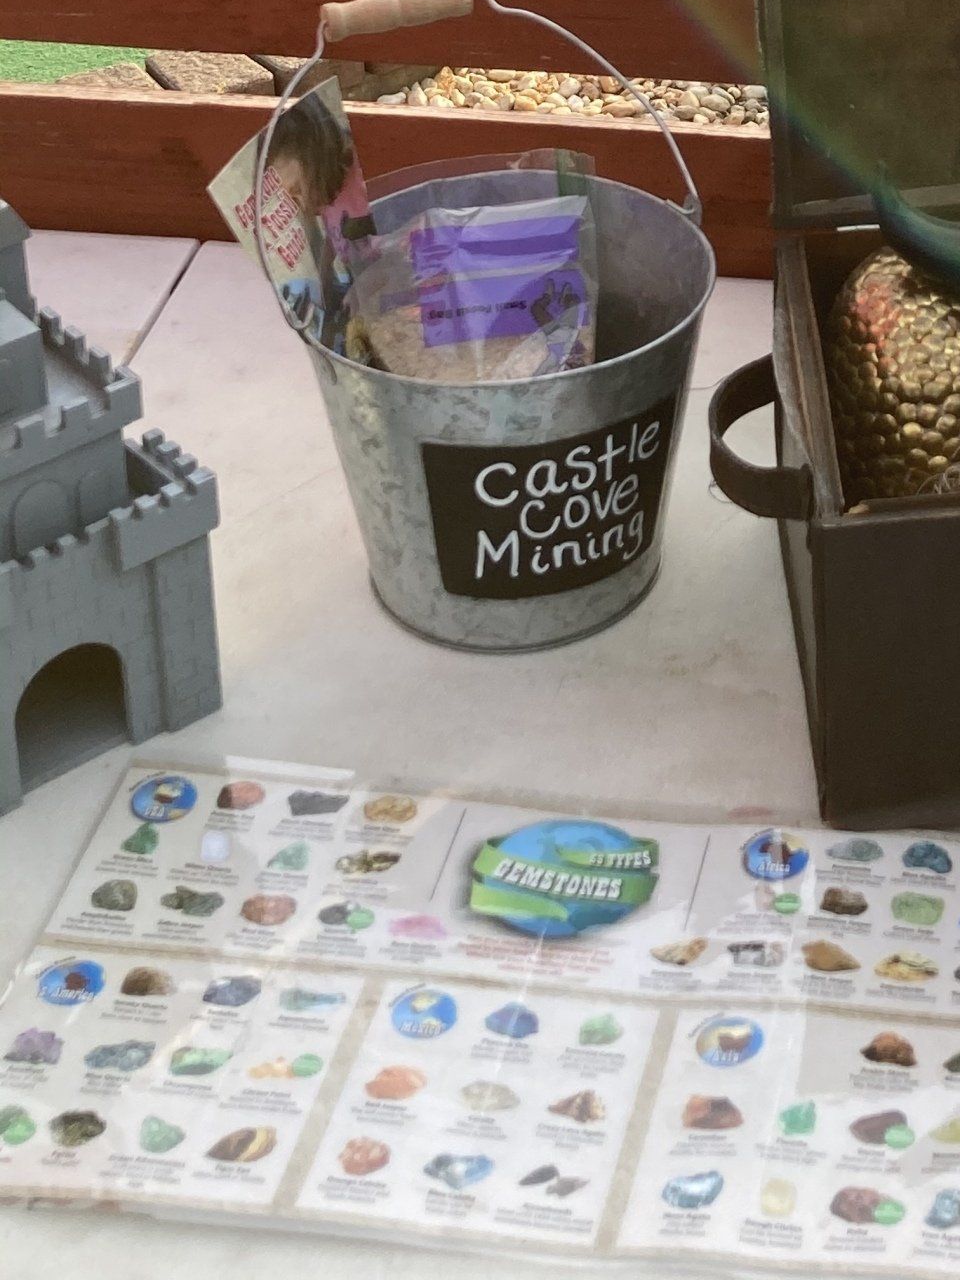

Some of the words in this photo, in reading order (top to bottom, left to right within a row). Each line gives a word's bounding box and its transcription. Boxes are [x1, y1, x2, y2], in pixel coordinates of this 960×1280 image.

[260, 188, 300, 239] Fossil
[474, 420, 660, 506] Castle
[519, 473, 640, 539] Cove
[475, 509, 644, 580] Mining
[493, 858, 622, 900] GEMSTONES
[608, 850, 652, 869] TYPES
